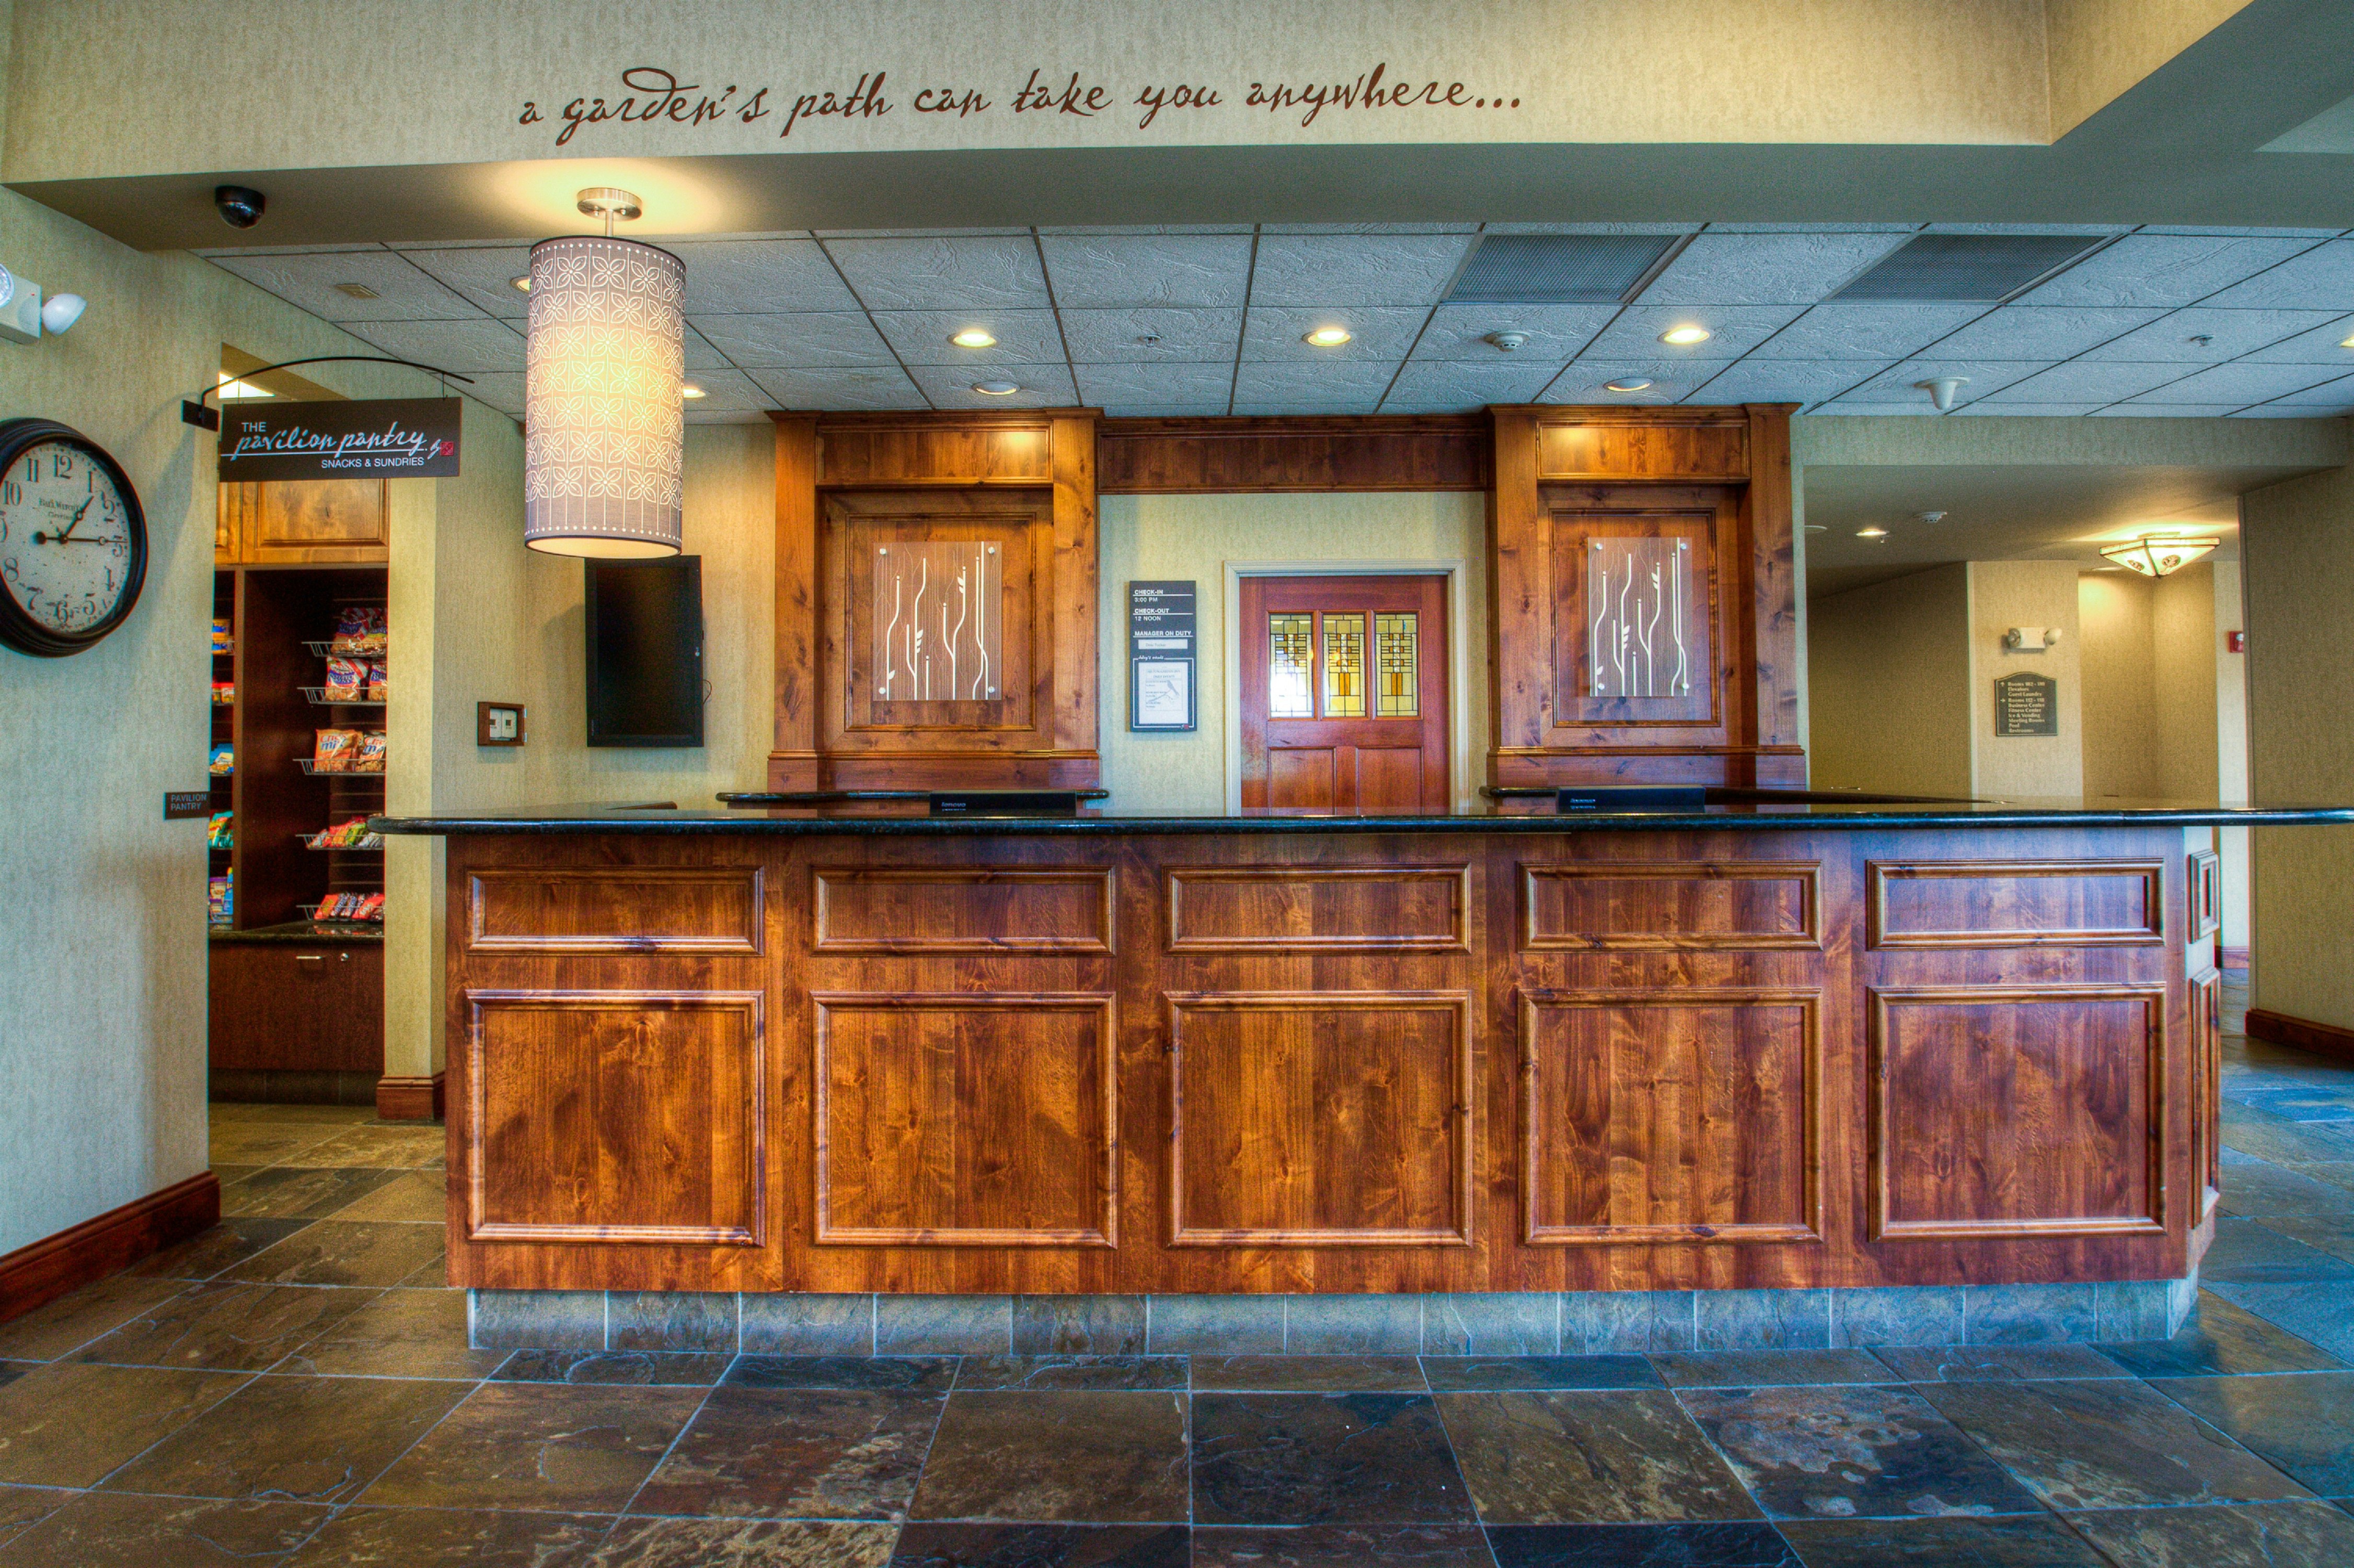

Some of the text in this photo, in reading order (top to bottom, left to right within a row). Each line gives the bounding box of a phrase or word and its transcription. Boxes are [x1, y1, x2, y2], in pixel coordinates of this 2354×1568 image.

[519, 63, 1521, 146] a garden's path can take you anywhere...
[241, 422, 267, 433] THE
[230, 421, 428, 461] pavilion pantry
[27, 458, 40, 483] 11
[53, 454, 73, 480] 12
[321, 457, 425, 469] SNACKS & SUNDRIES
[3, 481, 22, 506] 10
[101, 490, 117, 522] 2
[4, 558, 20, 582] 8
[27, 585, 43, 611] 7
[82, 592, 96, 616] 5
[170, 802, 202, 811] PANTRY
[171, 793, 207, 802] PAVILION
